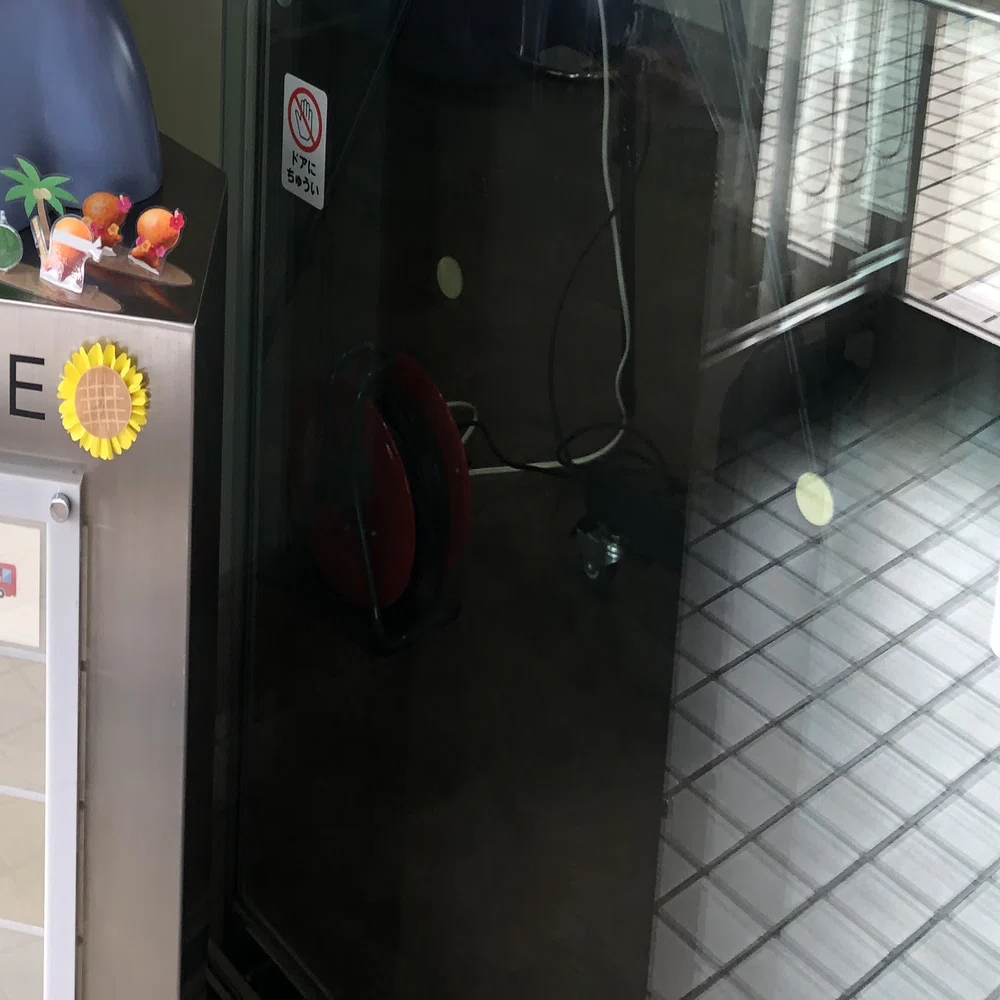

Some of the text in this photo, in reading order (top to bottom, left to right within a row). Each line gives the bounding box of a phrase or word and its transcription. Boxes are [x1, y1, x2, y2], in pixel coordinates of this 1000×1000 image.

[292, 150, 316, 176] ドアに
[287, 168, 319, 195] ちゅうい
